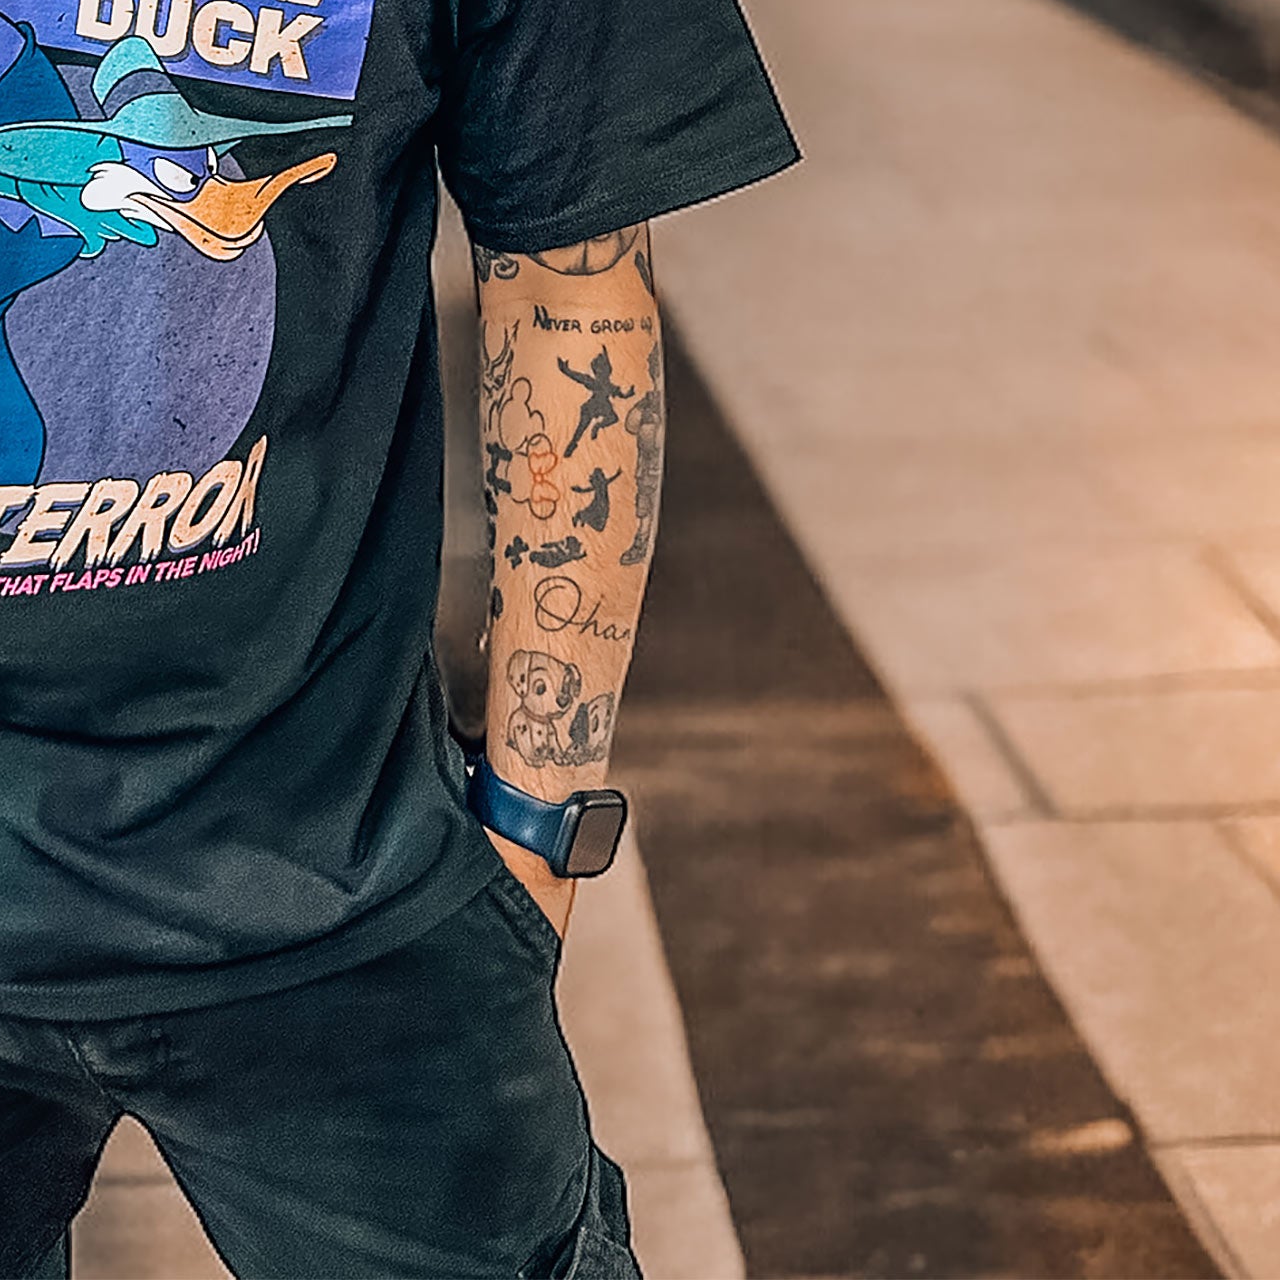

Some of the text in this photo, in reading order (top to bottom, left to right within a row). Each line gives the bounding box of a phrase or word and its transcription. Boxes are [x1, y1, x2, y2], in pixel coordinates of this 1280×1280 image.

[50, 567, 124, 593] FLAPS
[124, 564, 150, 586] IN
[154, 555, 198, 582] THE
[198, 527, 260, 574] NIGHT!
